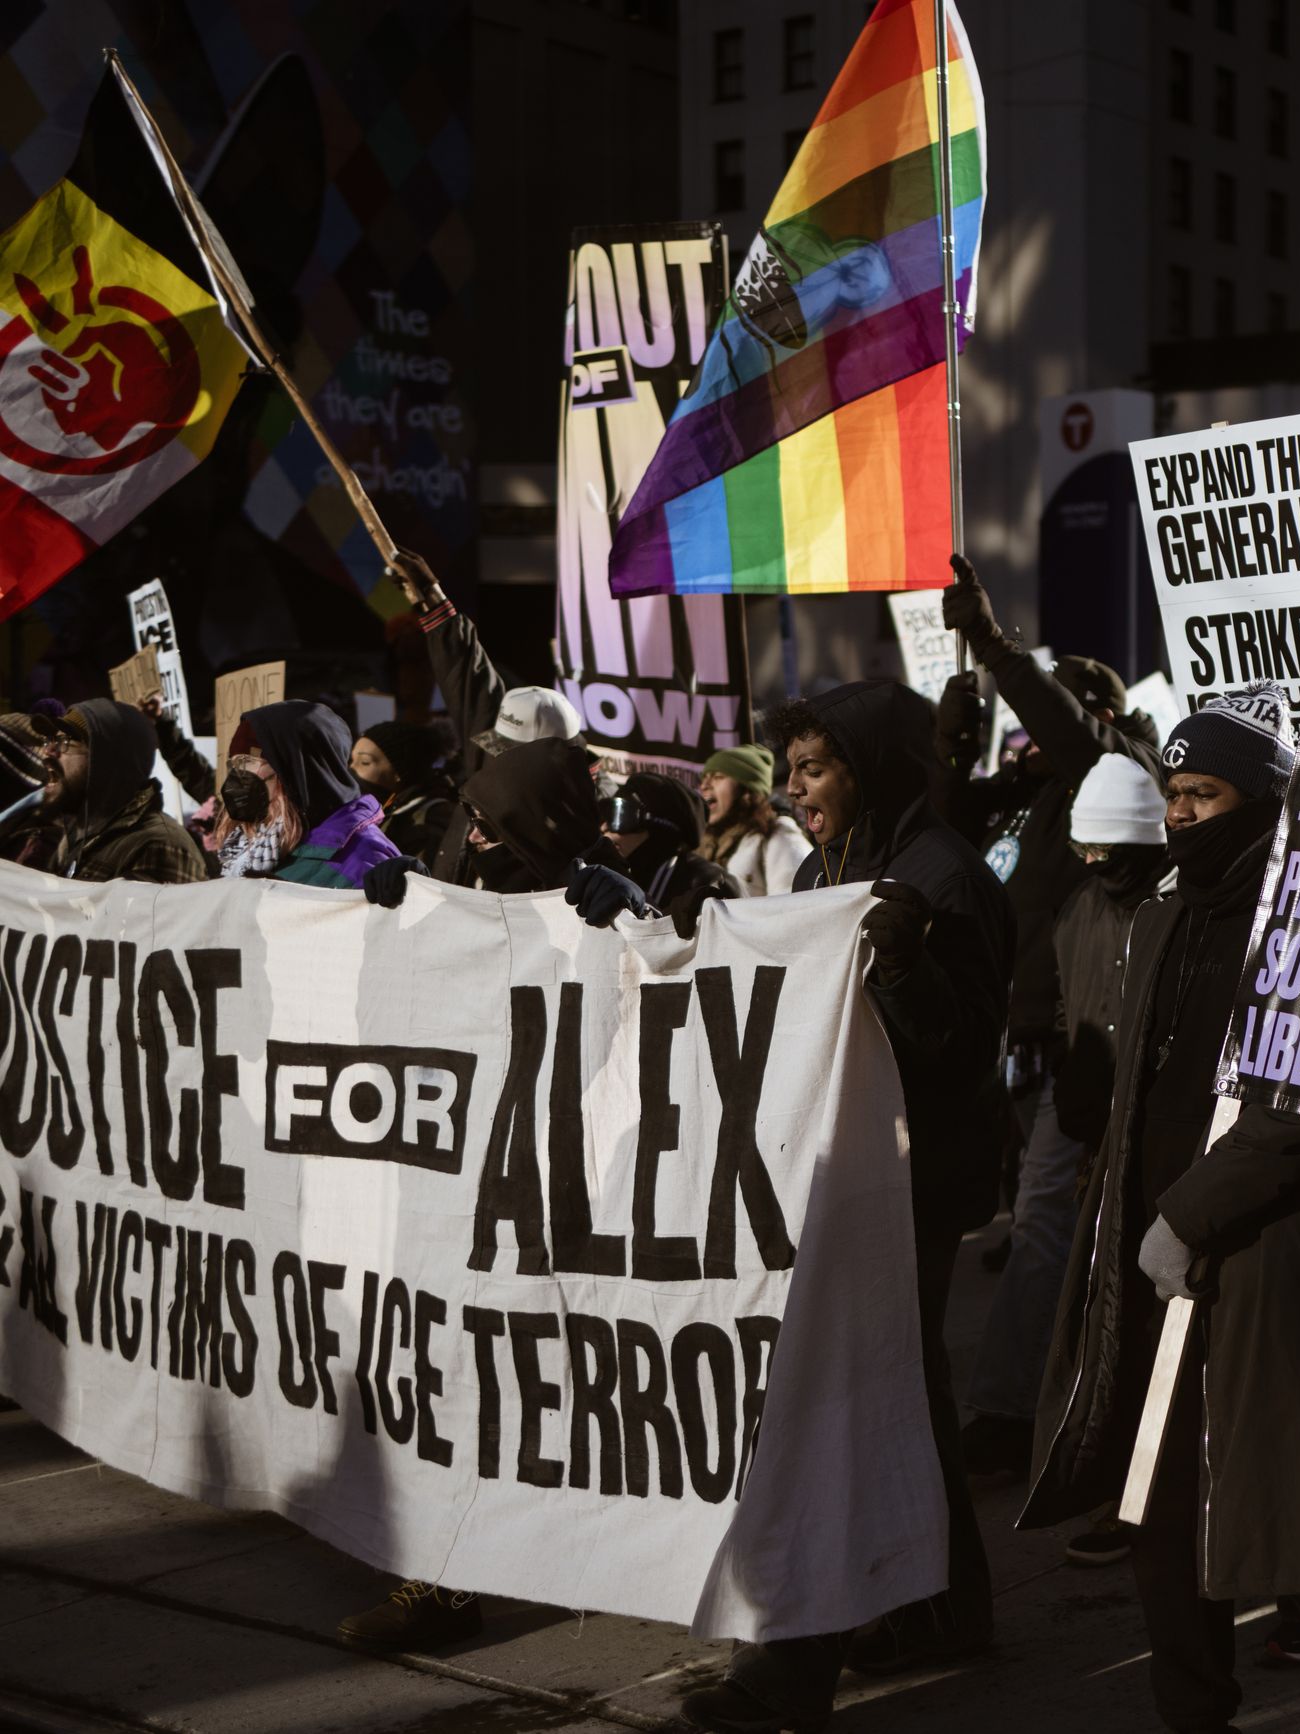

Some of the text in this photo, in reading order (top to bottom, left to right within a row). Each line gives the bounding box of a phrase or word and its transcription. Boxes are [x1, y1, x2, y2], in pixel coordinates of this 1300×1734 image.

[369, 288, 430, 338] The
[575, 239, 714, 370] OUT
[354, 334, 452, 385] times
[571, 360, 620, 398] OF
[319, 377, 464, 443] they are
[1144, 442, 1256, 511] EXPAND
[902, 606, 943, 633] RENE
[0, 924, 246, 1211] USTICE
[273, 1060, 460, 1153] FOR
[466, 964, 797, 1281] ALEX
[75, 1199, 259, 1399] VICTIMS
[272, 1247, 347, 1416] OF
[355, 1268, 455, 1468] ICE
[463, 1304, 785, 1505] TERROR
